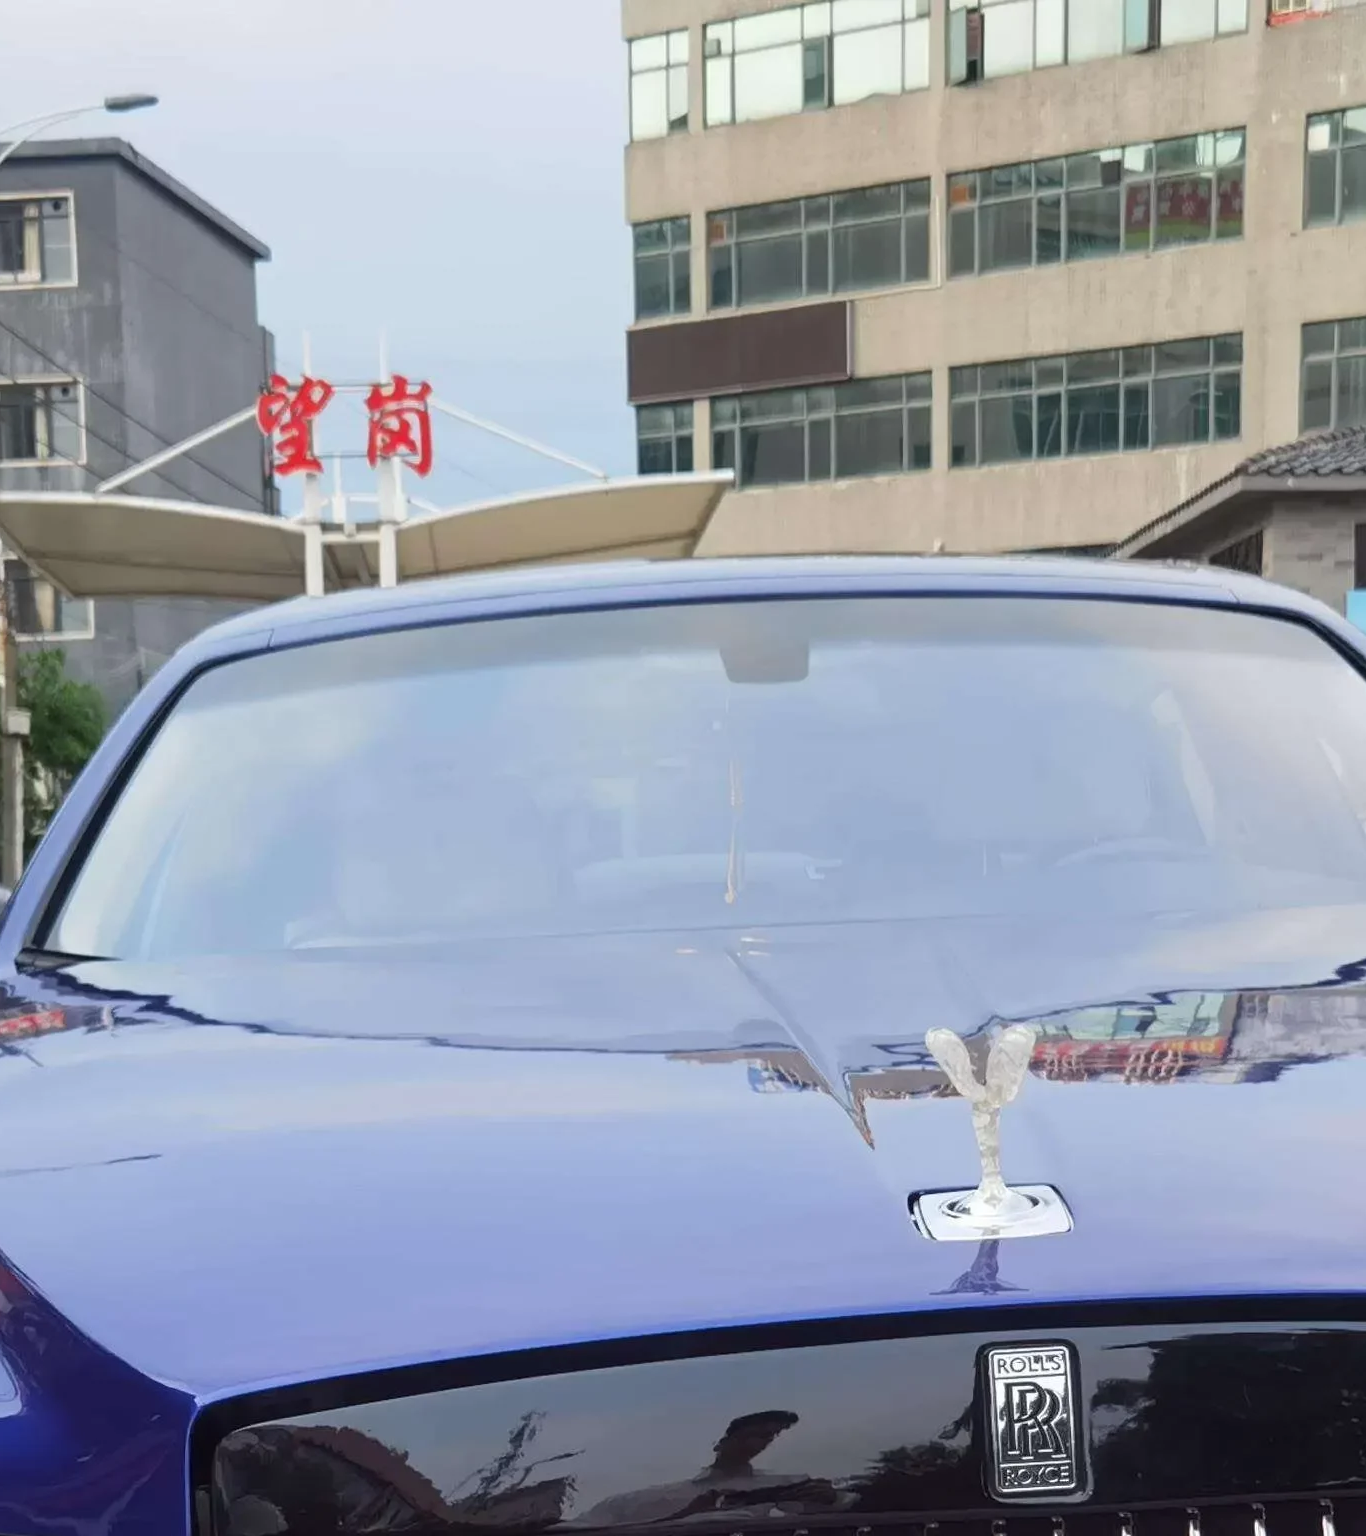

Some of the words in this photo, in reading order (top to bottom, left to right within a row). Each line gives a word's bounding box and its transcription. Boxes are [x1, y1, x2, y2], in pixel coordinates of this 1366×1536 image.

[256, 373, 433, 480] 望岗
[997, 1354, 1063, 1374] ROLLS
[1004, 1466, 1070, 1486] ROYCE
